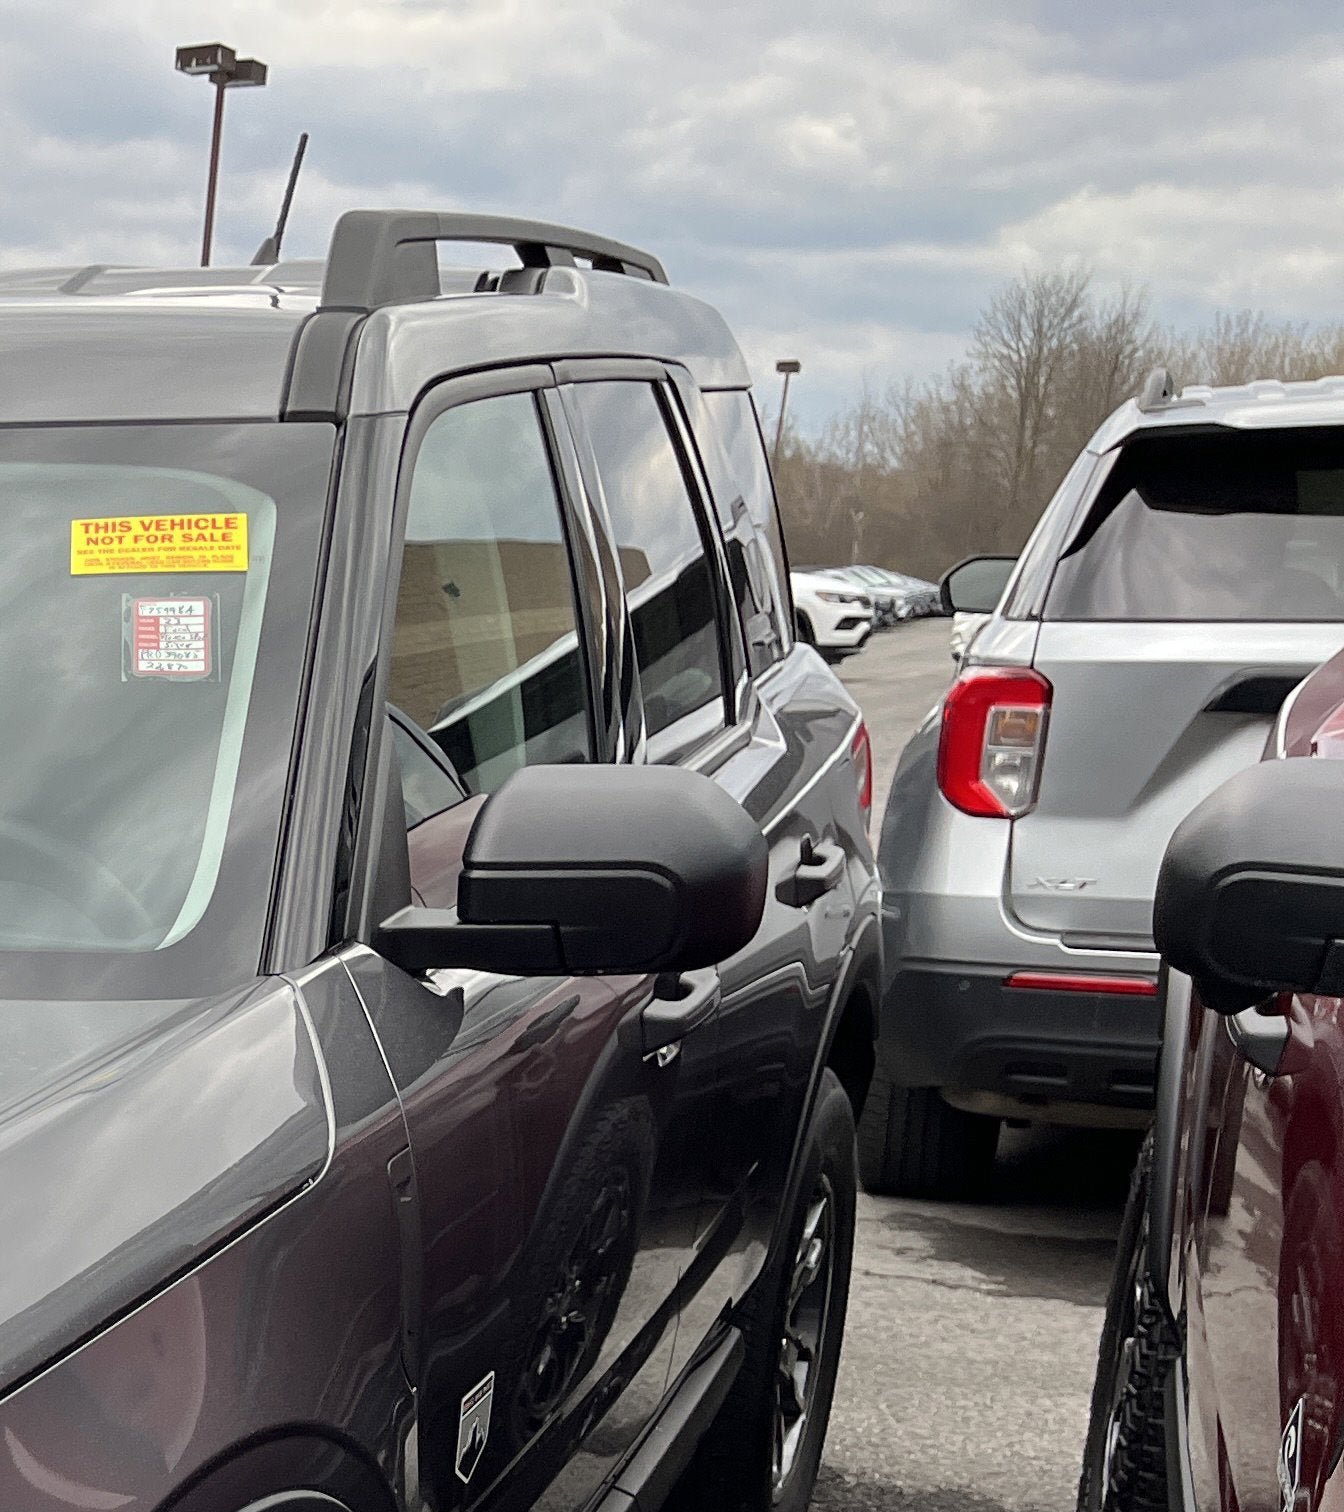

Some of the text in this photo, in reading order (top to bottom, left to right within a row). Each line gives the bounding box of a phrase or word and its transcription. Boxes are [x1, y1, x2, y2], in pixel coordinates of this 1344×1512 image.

[80, 517, 238, 534] THIS VEHICLE
[86, 532, 233, 546] NOT FOR SALE
[1025, 876, 1098, 892] XLT
